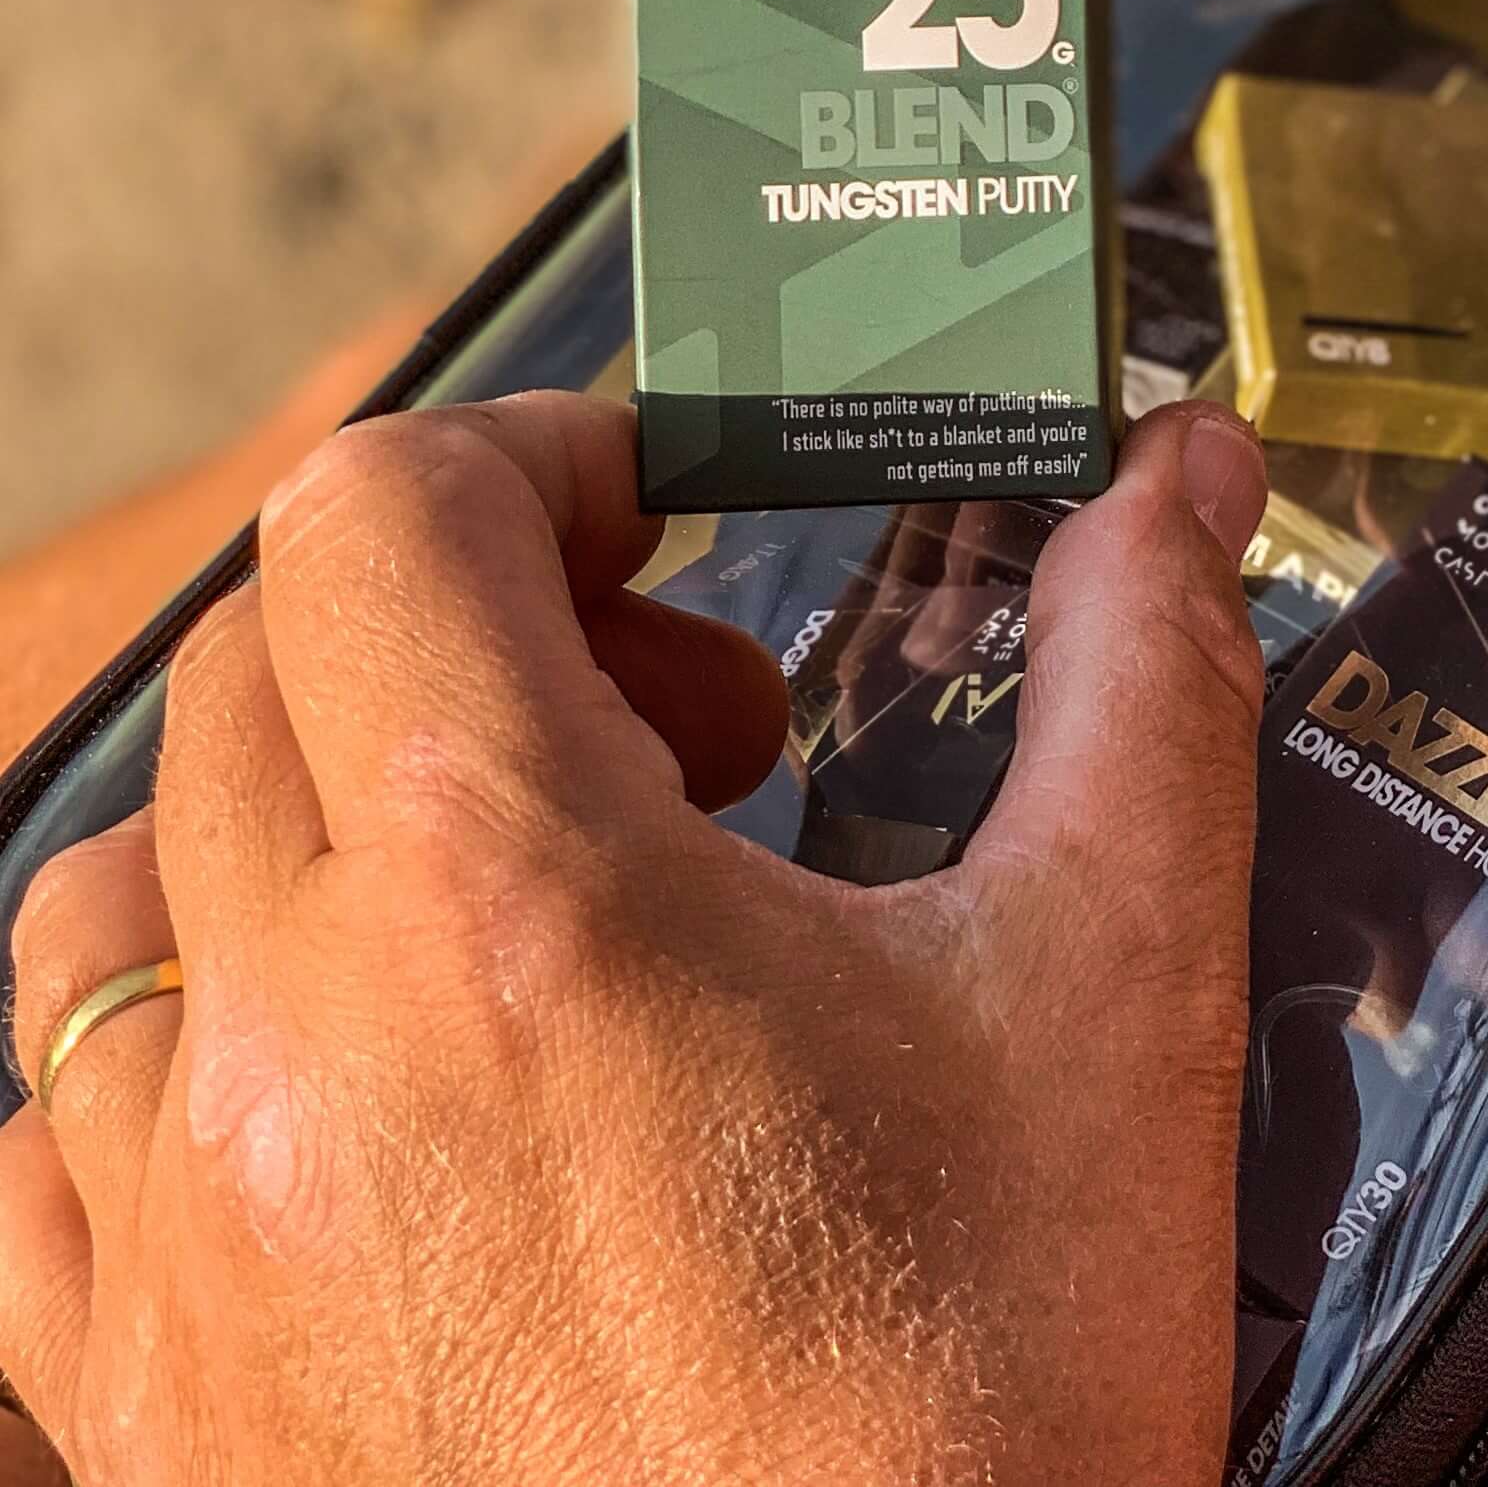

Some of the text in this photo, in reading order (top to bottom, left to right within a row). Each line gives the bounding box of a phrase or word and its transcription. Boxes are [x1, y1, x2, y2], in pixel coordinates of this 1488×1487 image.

[761, 174, 1078, 223] TUNGSTEN PUTTY
[830, 397, 844, 418] is
[849, 402, 868, 417] no
[873, 395, 918, 420] polite
[922, 398, 954, 417] way
[958, 392, 975, 412] of
[980, 390, 1035, 416] putting
[1039, 388, 1086, 409] this...
[783, 431, 788, 452] I
[792, 430, 833, 452] stick
[836, 429, 864, 450] like
[908, 429, 924, 447] to
[929, 431, 938, 446] a
[943, 424, 1002, 446] blanket
[1007, 421, 1036, 443] and
[1040, 420, 1087, 446] you're
[887, 461, 913, 481] not
[918, 458, 974, 484] getting
[978, 461, 1002, 477] me
[1007, 454, 1029, 476] off
[972, 608, 1010, 655] CAST
[1283, 718, 1360, 778] LONG
[1352, 761, 1475, 855] DISTANCE
[1321, 1161, 1407, 1260] QTY30
